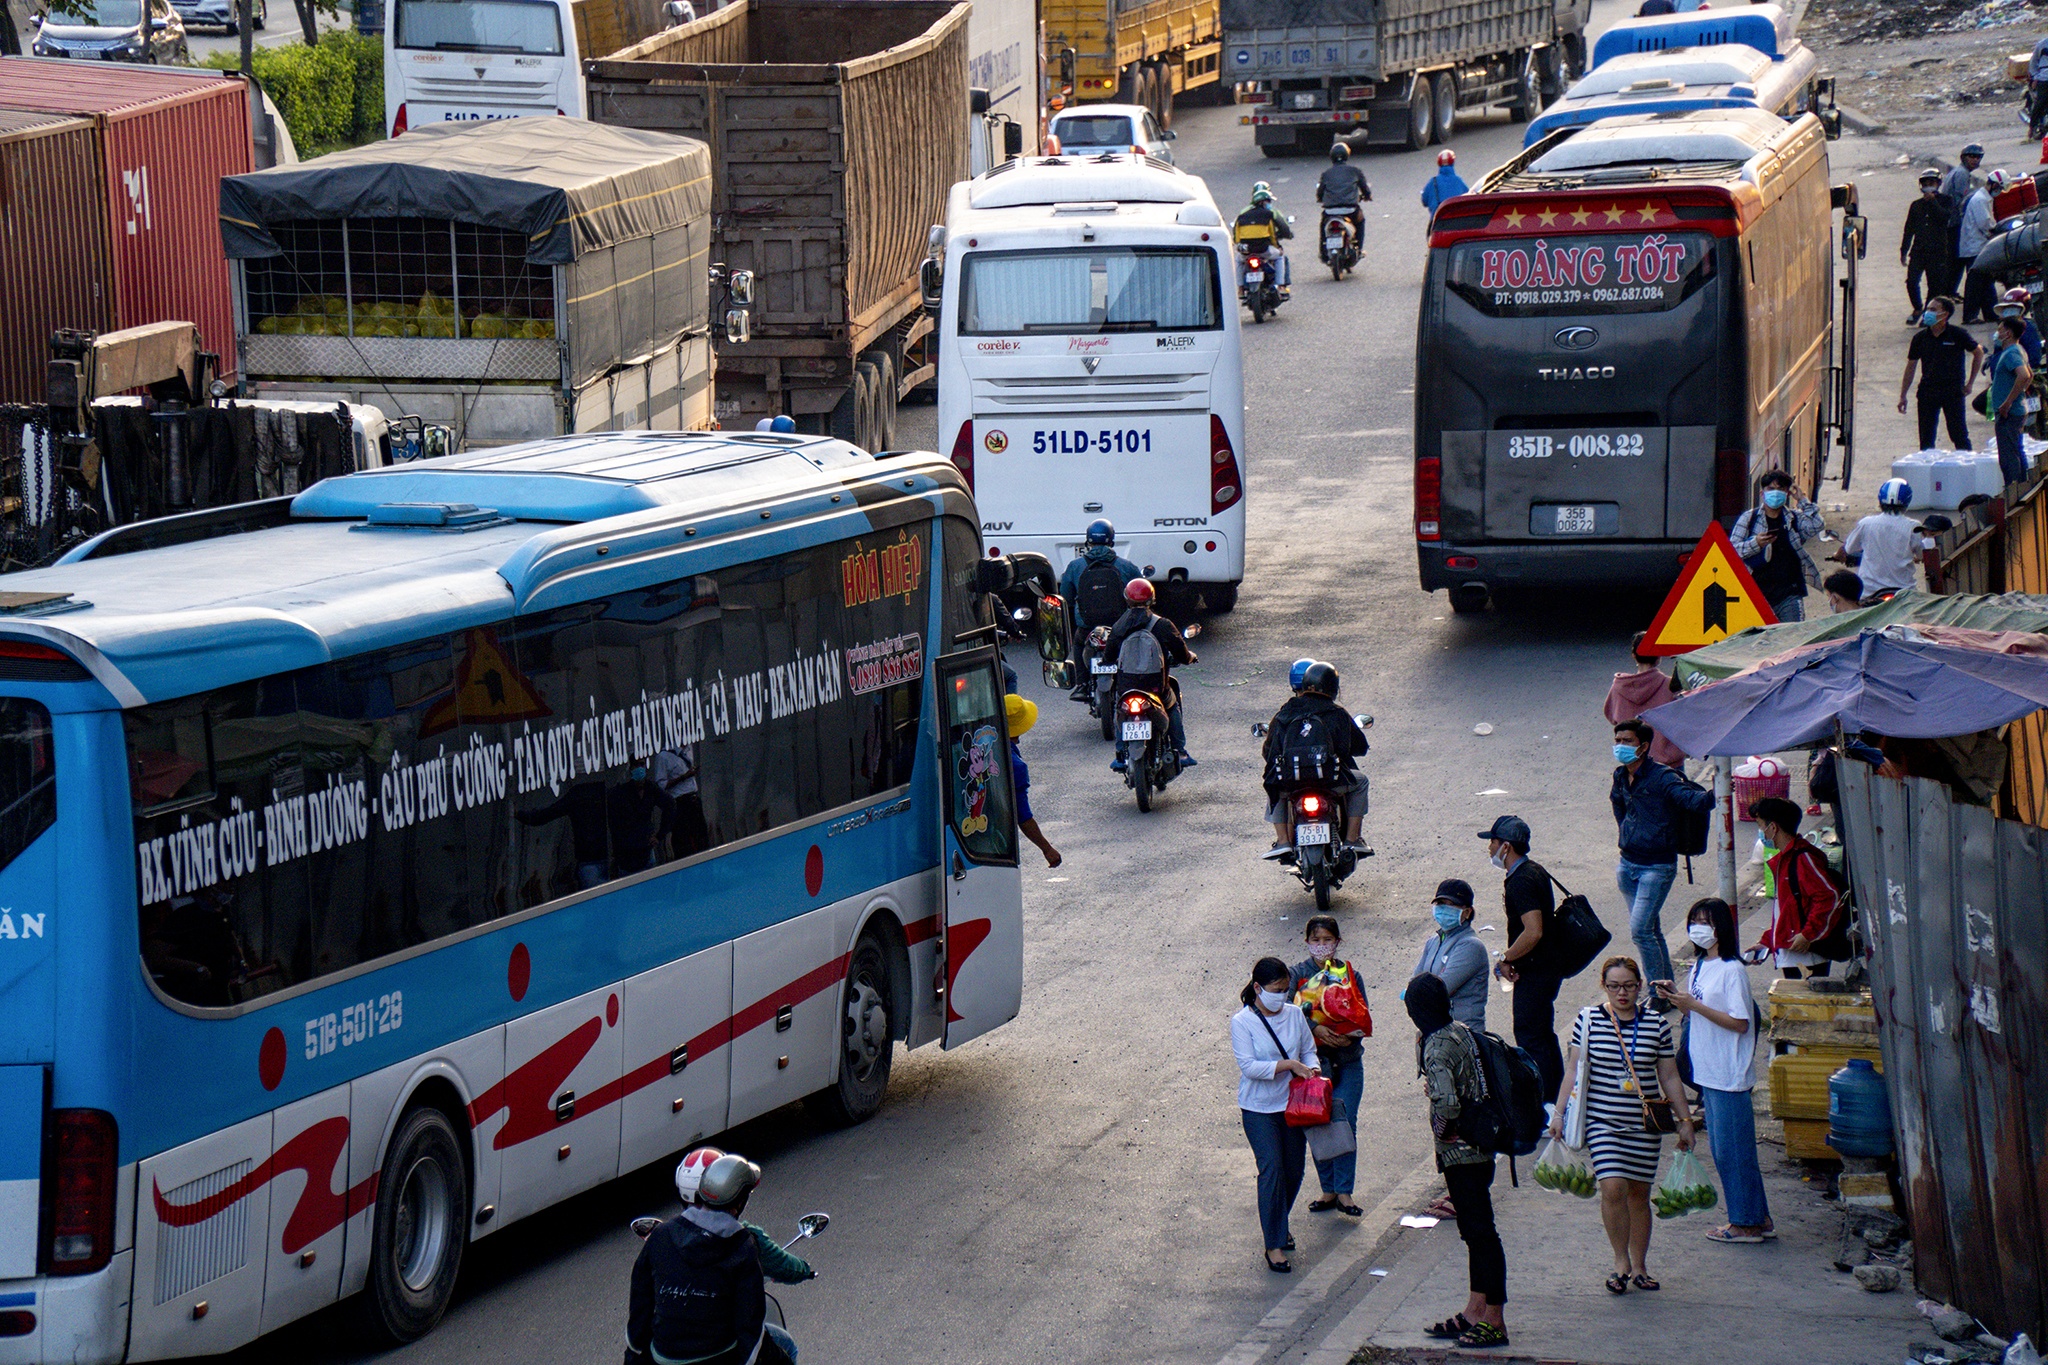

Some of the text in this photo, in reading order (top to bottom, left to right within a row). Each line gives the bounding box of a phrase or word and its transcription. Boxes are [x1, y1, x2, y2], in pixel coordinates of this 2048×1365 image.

[1480, 234, 1686, 288] HOÀNG TỐT
[1495, 286, 1664, 305] ĐT: 0918.029.379 0962.687.084
[977, 339, 1011, 350] corèle
[1538, 366, 1616, 380] THACO
[1033, 429, 1151, 454] 51LD-5101
[1509, 436, 1553, 458] 35B
[1569, 434, 1645, 457] 008.22
[1565, 508, 1586, 519] 35B
[981, 521, 1014, 531] AUV
[1153, 517, 1208, 527] FOTON
[1557, 519, 1593, 531] 008.22
[841, 529, 921, 608] HÒA HIỆP
[1126, 723, 1147, 731] 63-P1
[1124, 731, 1150, 739] 126.16
[139, 813, 218, 907] BX.VĨNH
[264, 787, 308, 867] BÌNH
[308, 772, 368, 853] DƯƠNG
[381, 749, 415, 832] CẦU
[416, 743, 448, 822] PHÚ
[514, 720, 546, 794] TÂN
[547, 723, 576, 798] QUY
[603, 709, 629, 769] CHI
[631, 688, 662, 770] HẬU
[711, 668, 731, 736] CÀ
[733, 671, 763, 731] MAU
[816, 639, 842, 705] CĂN
[1300, 834, 1328, 844] 393.71
